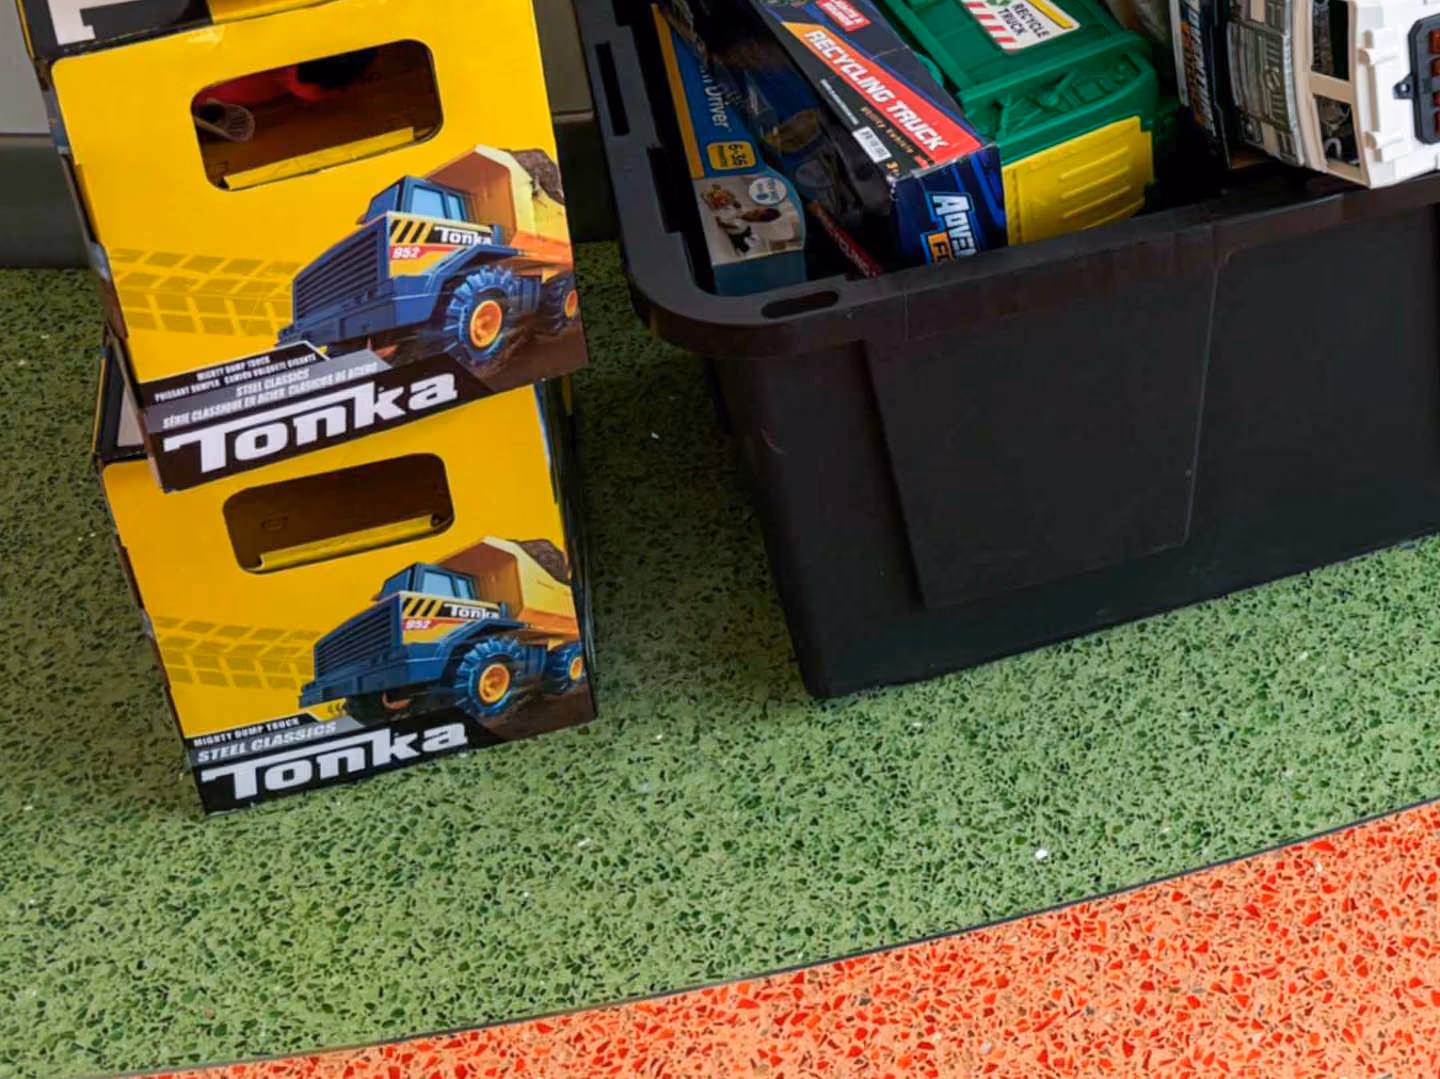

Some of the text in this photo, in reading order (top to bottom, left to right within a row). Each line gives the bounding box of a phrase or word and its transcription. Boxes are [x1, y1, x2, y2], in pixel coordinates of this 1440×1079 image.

[999, 8, 1027, 36] TRUCK
[1012, 3, 1050, 38] RECYCLE
[804, 30, 895, 102] RECYCLING
[886, 101, 949, 151] TRUCK
[704, 86, 730, 129] Driver
[434, 226, 492, 246] Tonka
[392, 247, 420, 259] 952
[235, 368, 309, 398] STEEL CLASSICS
[163, 372, 458, 474] Tonka
[443, 603, 499, 620] Tonka
[194, 717, 300, 748] MIGHTY DUMP TRUCK
[198, 721, 337, 763] STEEL CLASSICS
[201, 722, 469, 801] Tonka
